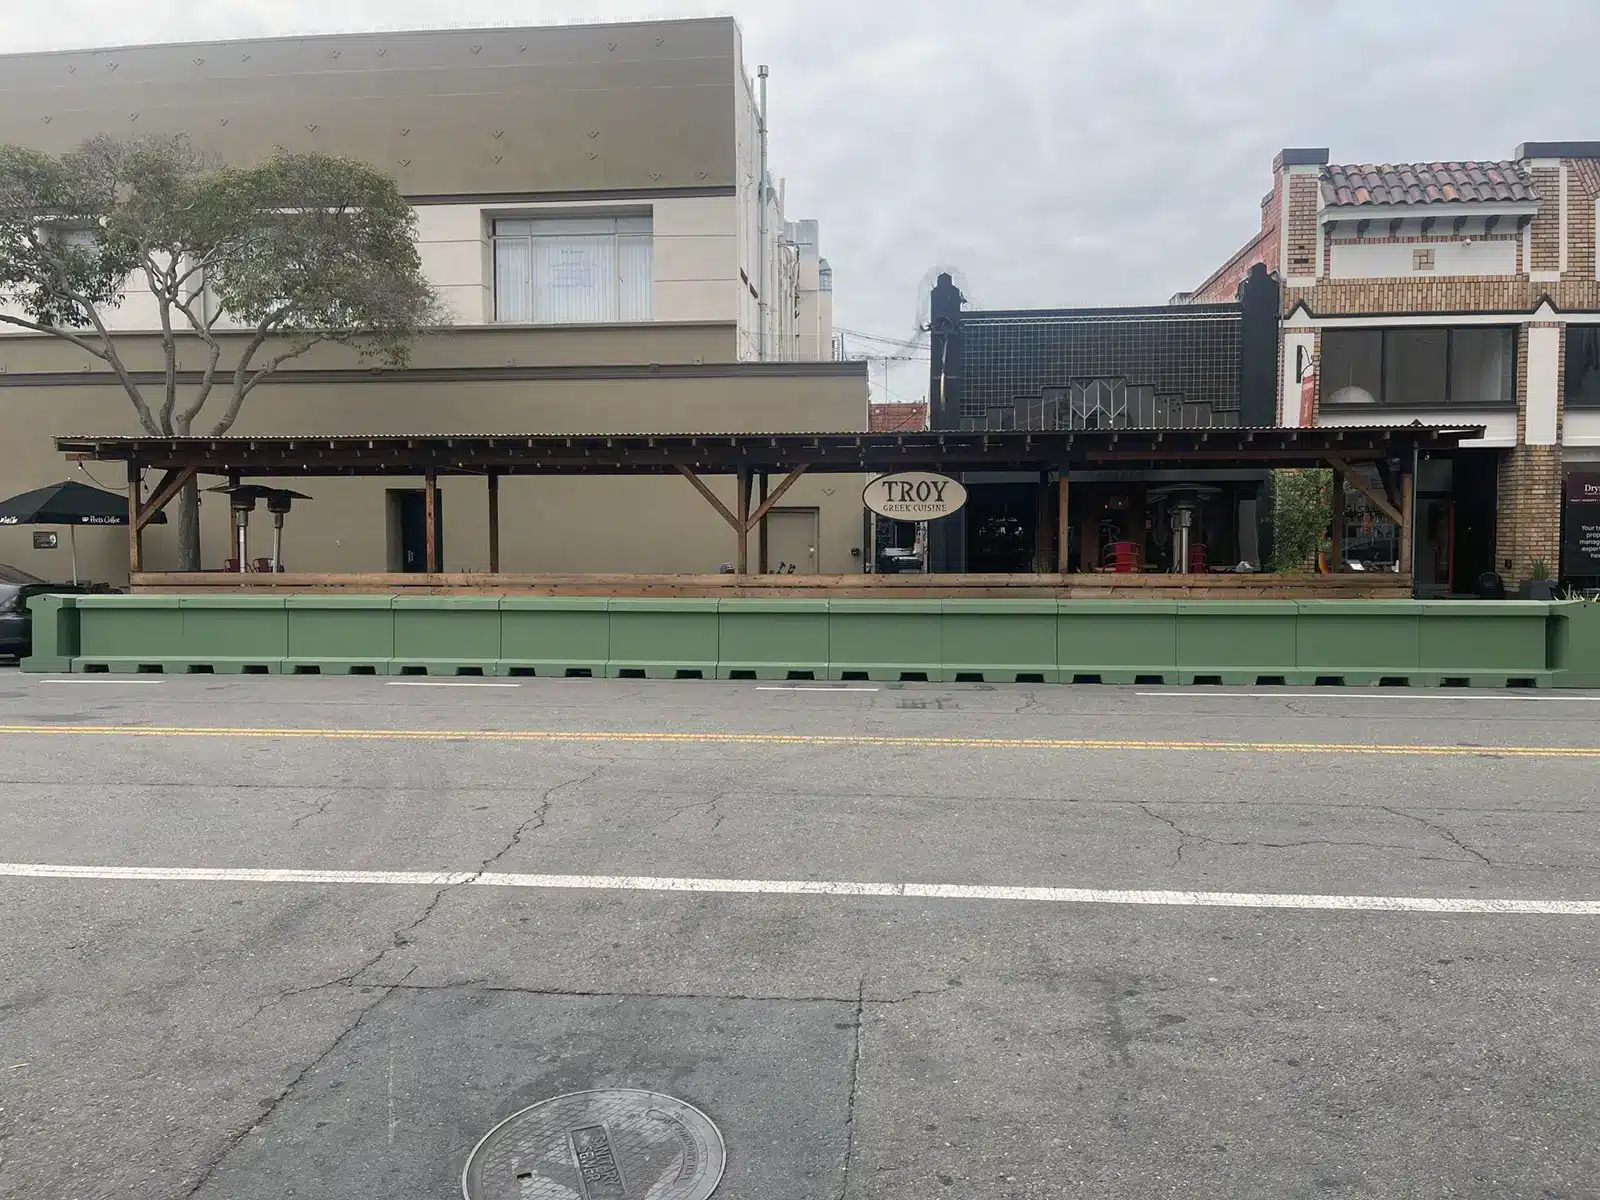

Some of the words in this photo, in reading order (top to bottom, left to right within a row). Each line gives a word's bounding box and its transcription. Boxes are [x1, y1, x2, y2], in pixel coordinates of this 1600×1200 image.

[882, 480, 949, 502] TROY
[883, 504, 911, 512] GREEK
[913, 504, 947, 512] CUISINE
[577, 1145, 601, 1184] SEWER
[591, 1134, 619, 1186] SANITARY
